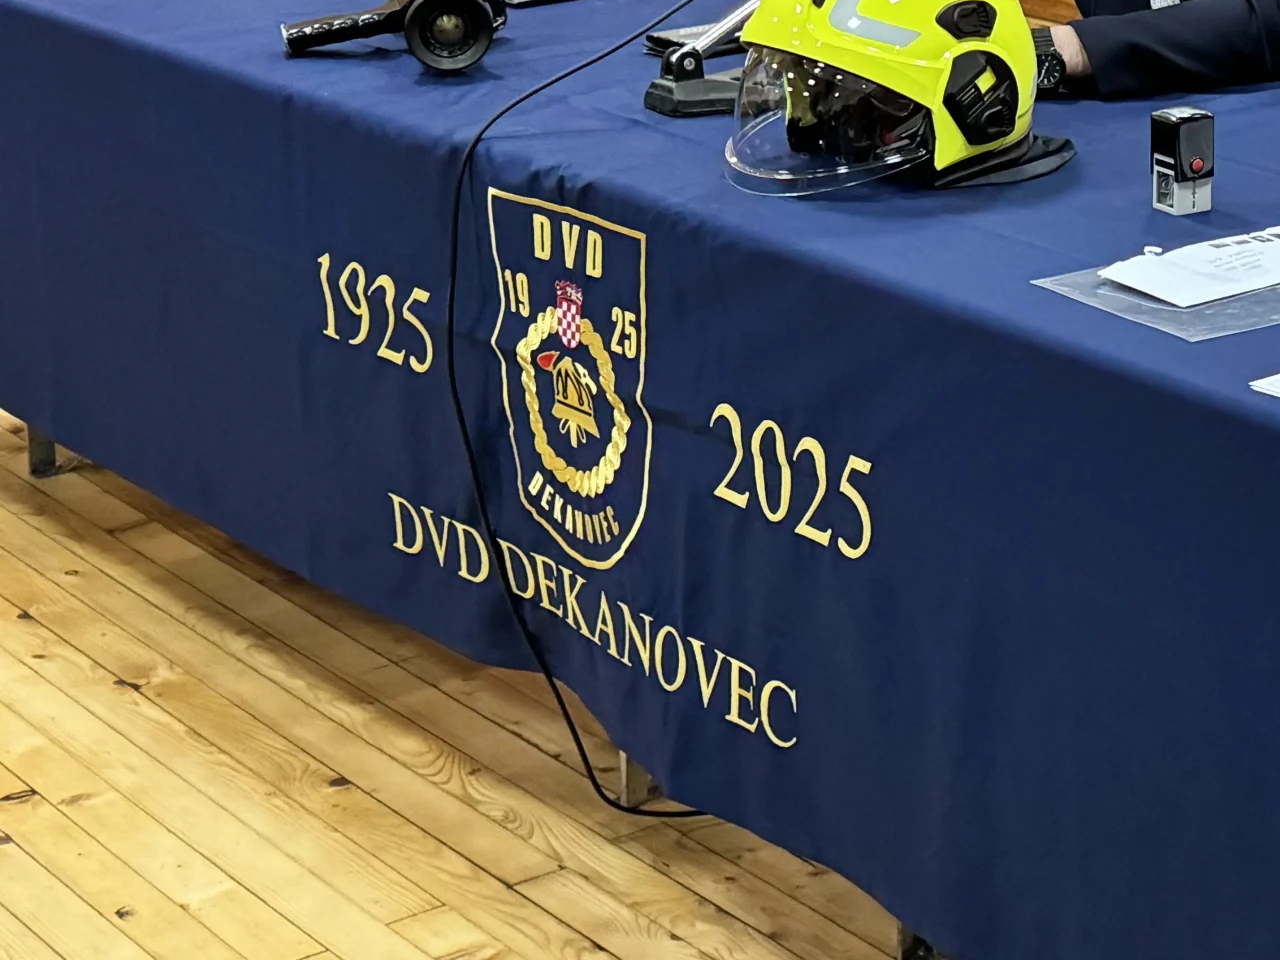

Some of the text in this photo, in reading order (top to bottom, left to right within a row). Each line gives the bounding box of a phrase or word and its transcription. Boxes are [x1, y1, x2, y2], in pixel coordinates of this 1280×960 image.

[533, 214, 603, 279] DVD
[317, 252, 434, 374] 1925
[503, 269, 531, 318] 19
[610, 307, 638, 359] 25
[528, 473, 620, 544] DEKANOVEC
[710, 403, 873, 560] 2025
[387, 493, 798, 751] DVD DEKANOVEC
